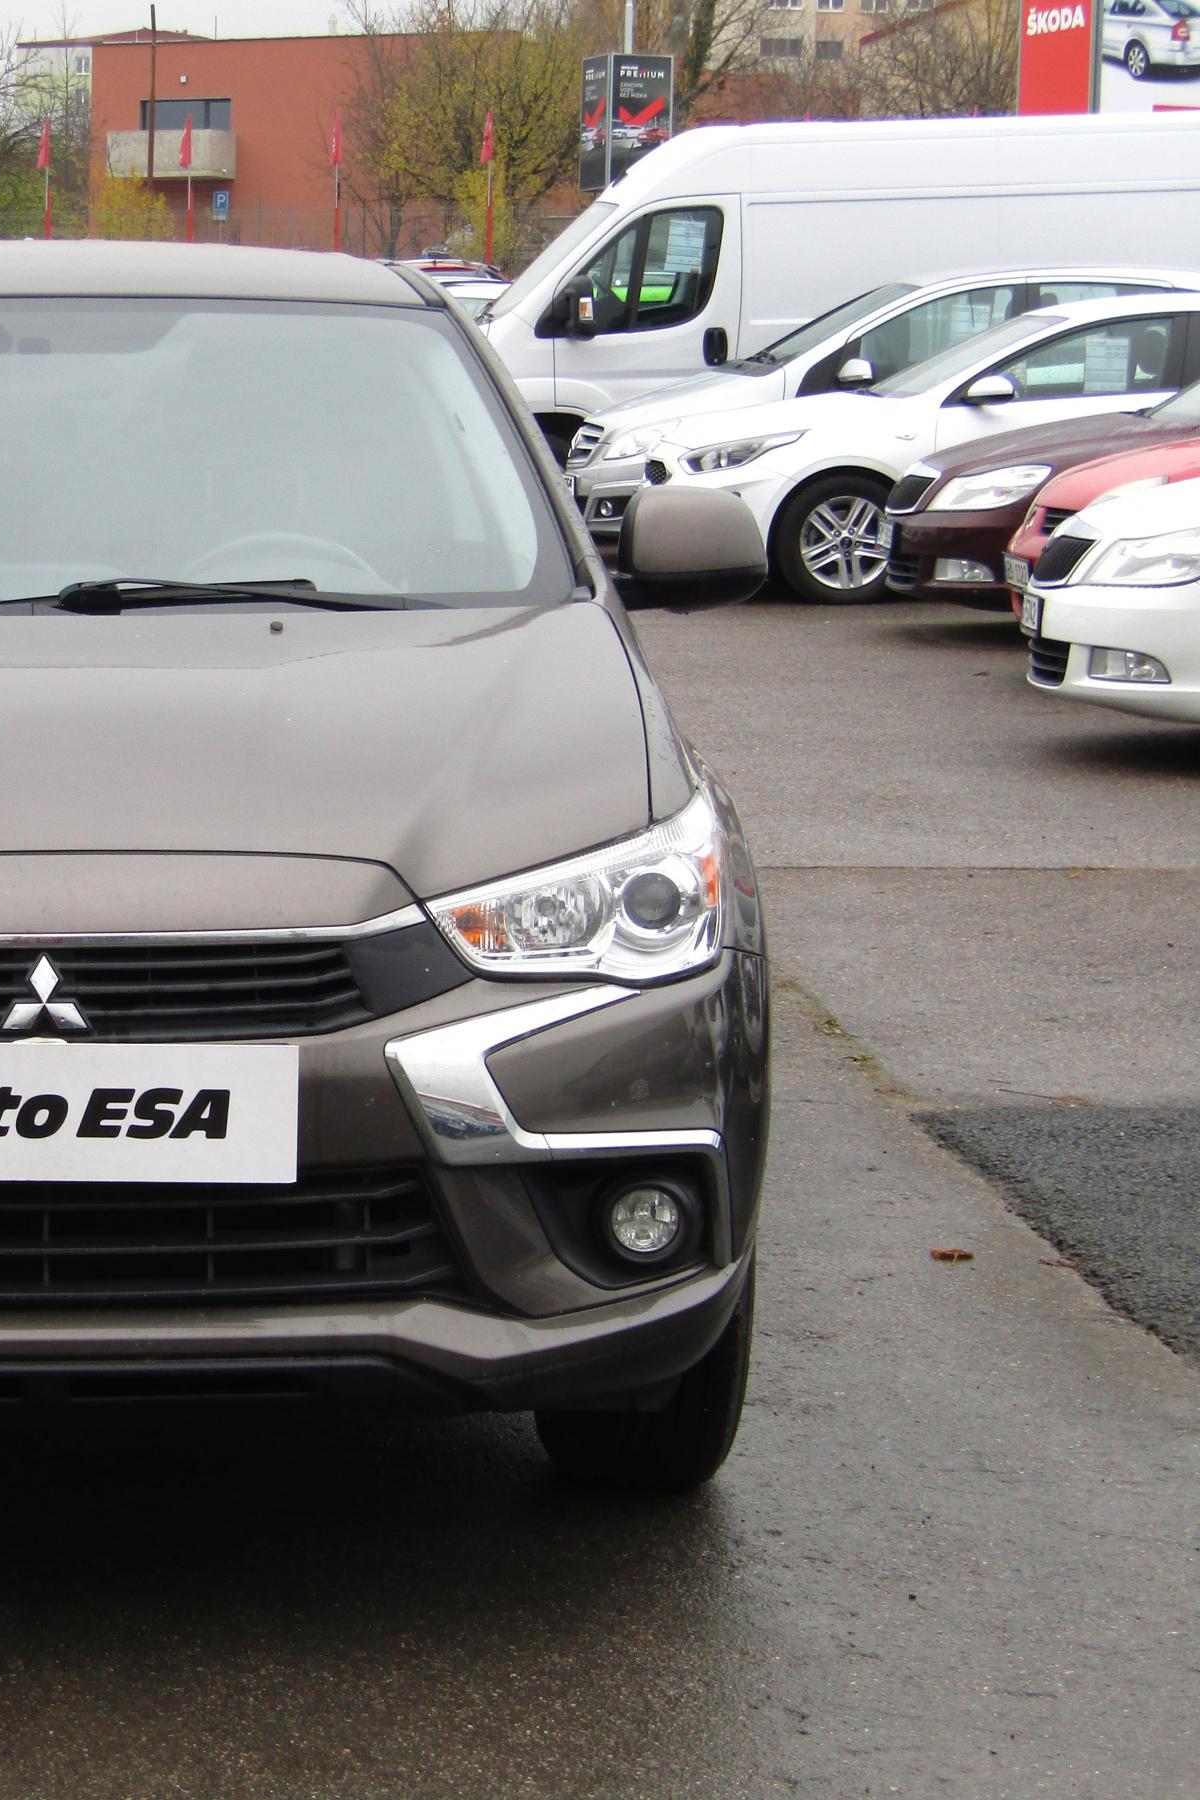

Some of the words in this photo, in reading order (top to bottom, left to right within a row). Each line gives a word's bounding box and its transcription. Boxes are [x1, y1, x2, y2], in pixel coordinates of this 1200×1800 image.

[1026, 4, 1086, 37] ŠKODA
[620, 70, 665, 79] PREMIUM
[217, 194, 226, 208] P
[76, 1087, 231, 1139] ESA
